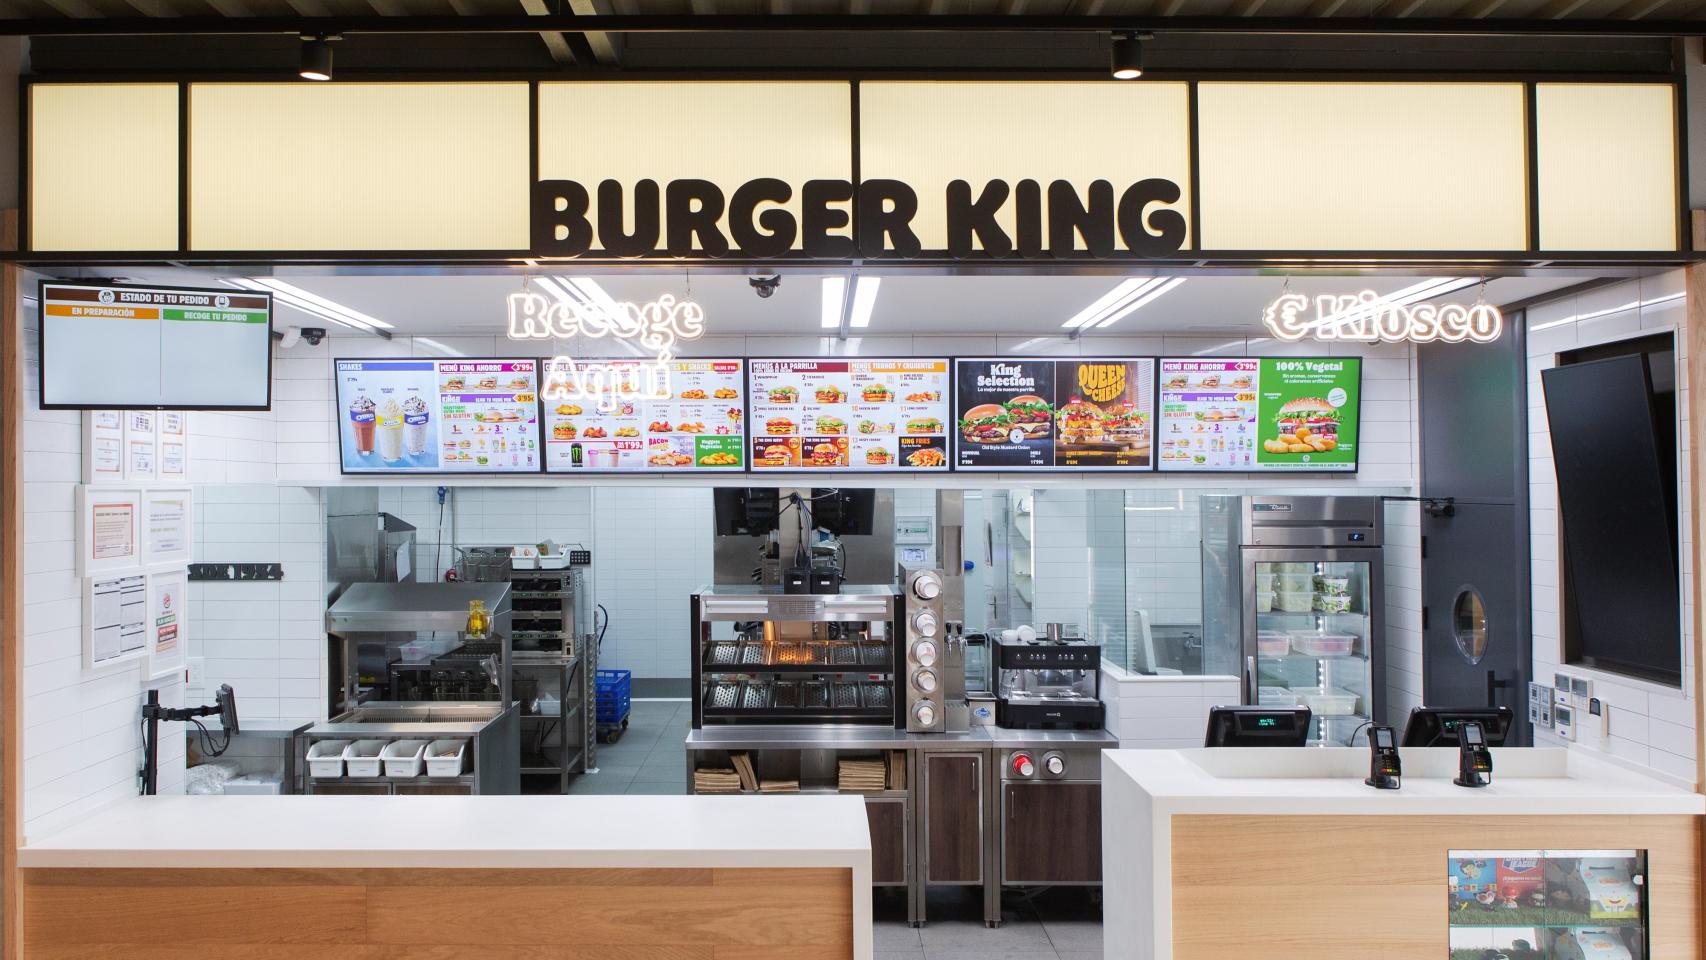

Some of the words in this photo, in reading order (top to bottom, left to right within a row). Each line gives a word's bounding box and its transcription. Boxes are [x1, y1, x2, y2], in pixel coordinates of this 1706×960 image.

[532, 178, 921, 259] BURGER
[945, 178, 1180, 259] KING
[120, 292, 152, 303] ESTADO
[153, 293, 165, 304] DE
[166, 294, 178, 304] TU
[178, 295, 210, 305] PEDIDO
[71, 307, 82, 315] EN
[83, 307, 135, 318] PREPARACIÓN
[183, 311, 211, 321] RECOGE
[212, 312, 221, 321] TU
[222, 313, 248, 322] PEDIDO
[1312, 289, 1503, 343] Kiosco
[507, 292, 705, 350] Recoge
[339, 363, 363, 371] SHAKES
[440, 363, 458, 371] MENÚ
[459, 364, 475, 372] KING
[476, 364, 503, 372] AHORRO
[753, 362, 773, 370] MENÚS
[774, 362, 780, 370] A
[780, 362, 789, 370] LA
[789, 362, 818, 370] PARRILLA
[990, 363, 1022, 378] King
[1163, 362, 1182, 370] MENÚ
[1276, 362, 1304, 371] 100%
[1305, 362, 1344, 372] Vegetal
[541, 350, 676, 412] Aquí
[977, 375, 1035, 386] Selection
[1078, 364, 1126, 395] QUEEN
[1091, 378, 1126, 402] CHEESE
[495, 424, 499, 432] 3
[648, 438, 669, 446] BACON
